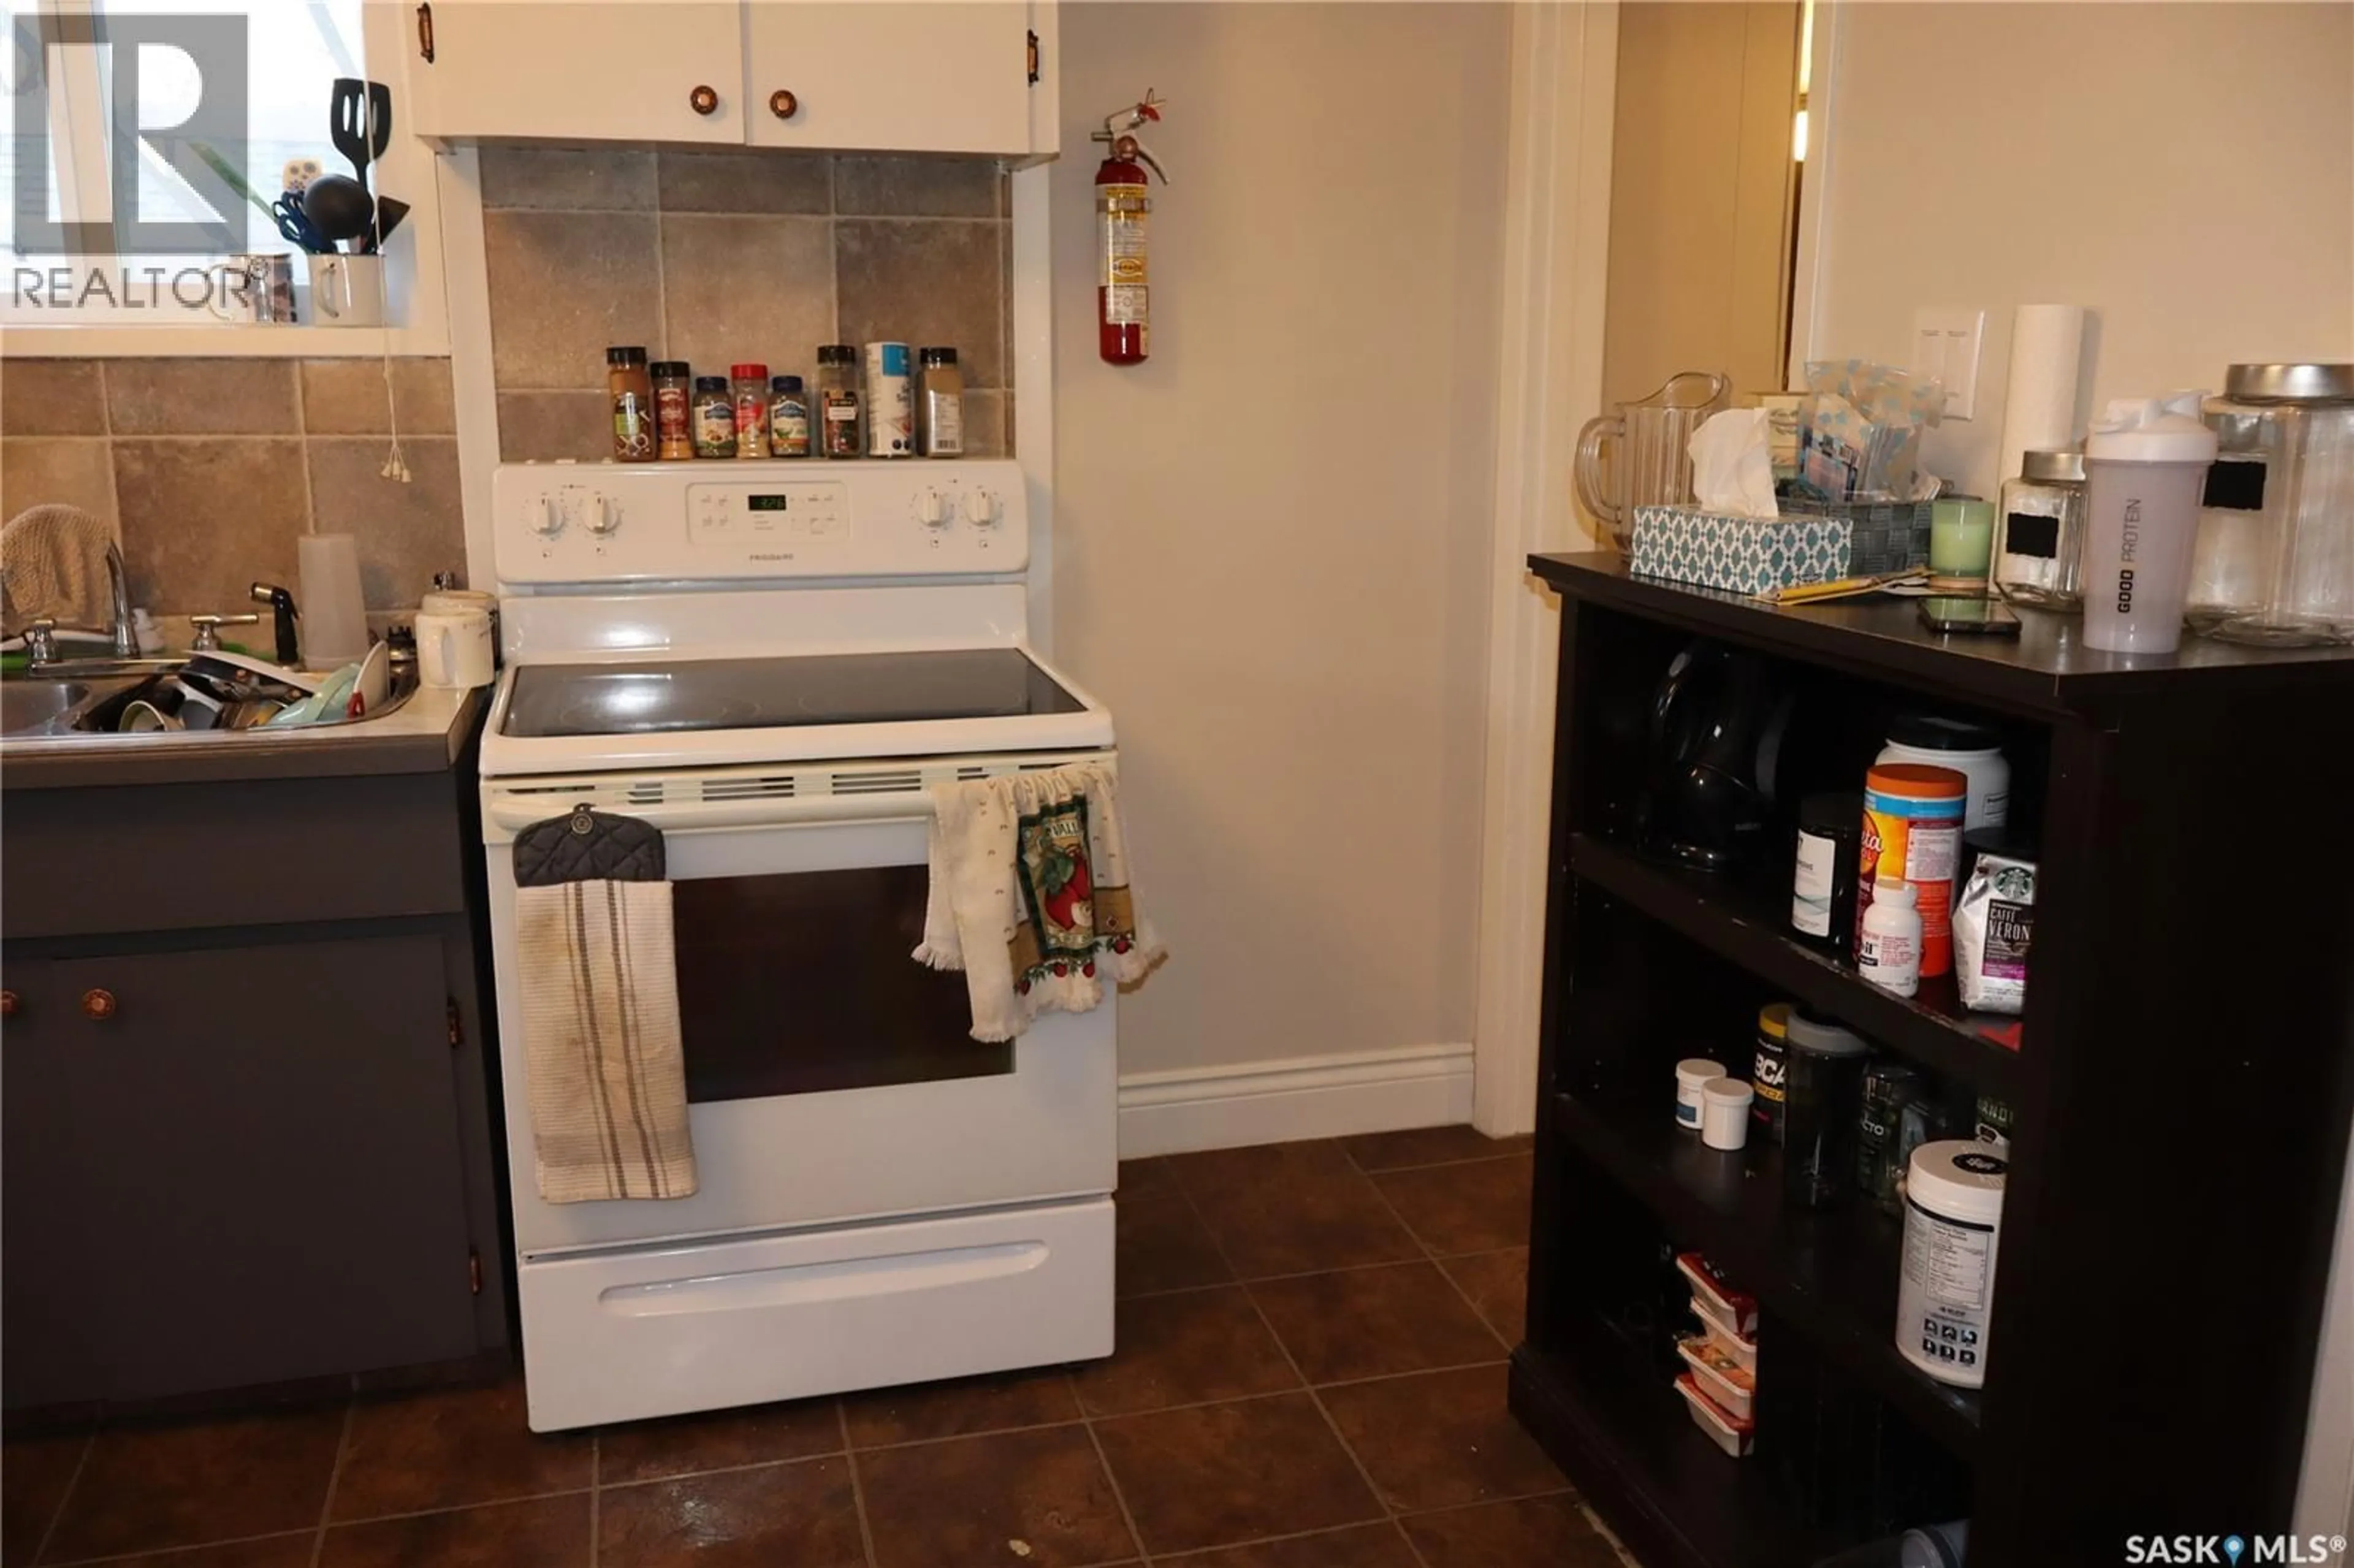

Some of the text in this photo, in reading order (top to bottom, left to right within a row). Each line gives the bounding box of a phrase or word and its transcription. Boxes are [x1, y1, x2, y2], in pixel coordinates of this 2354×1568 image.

[2117, 498, 2141, 613] GOOD PROTEIN
[1989, 919, 2033, 941] VERON
[1754, 1052, 1786, 1086] BCA
